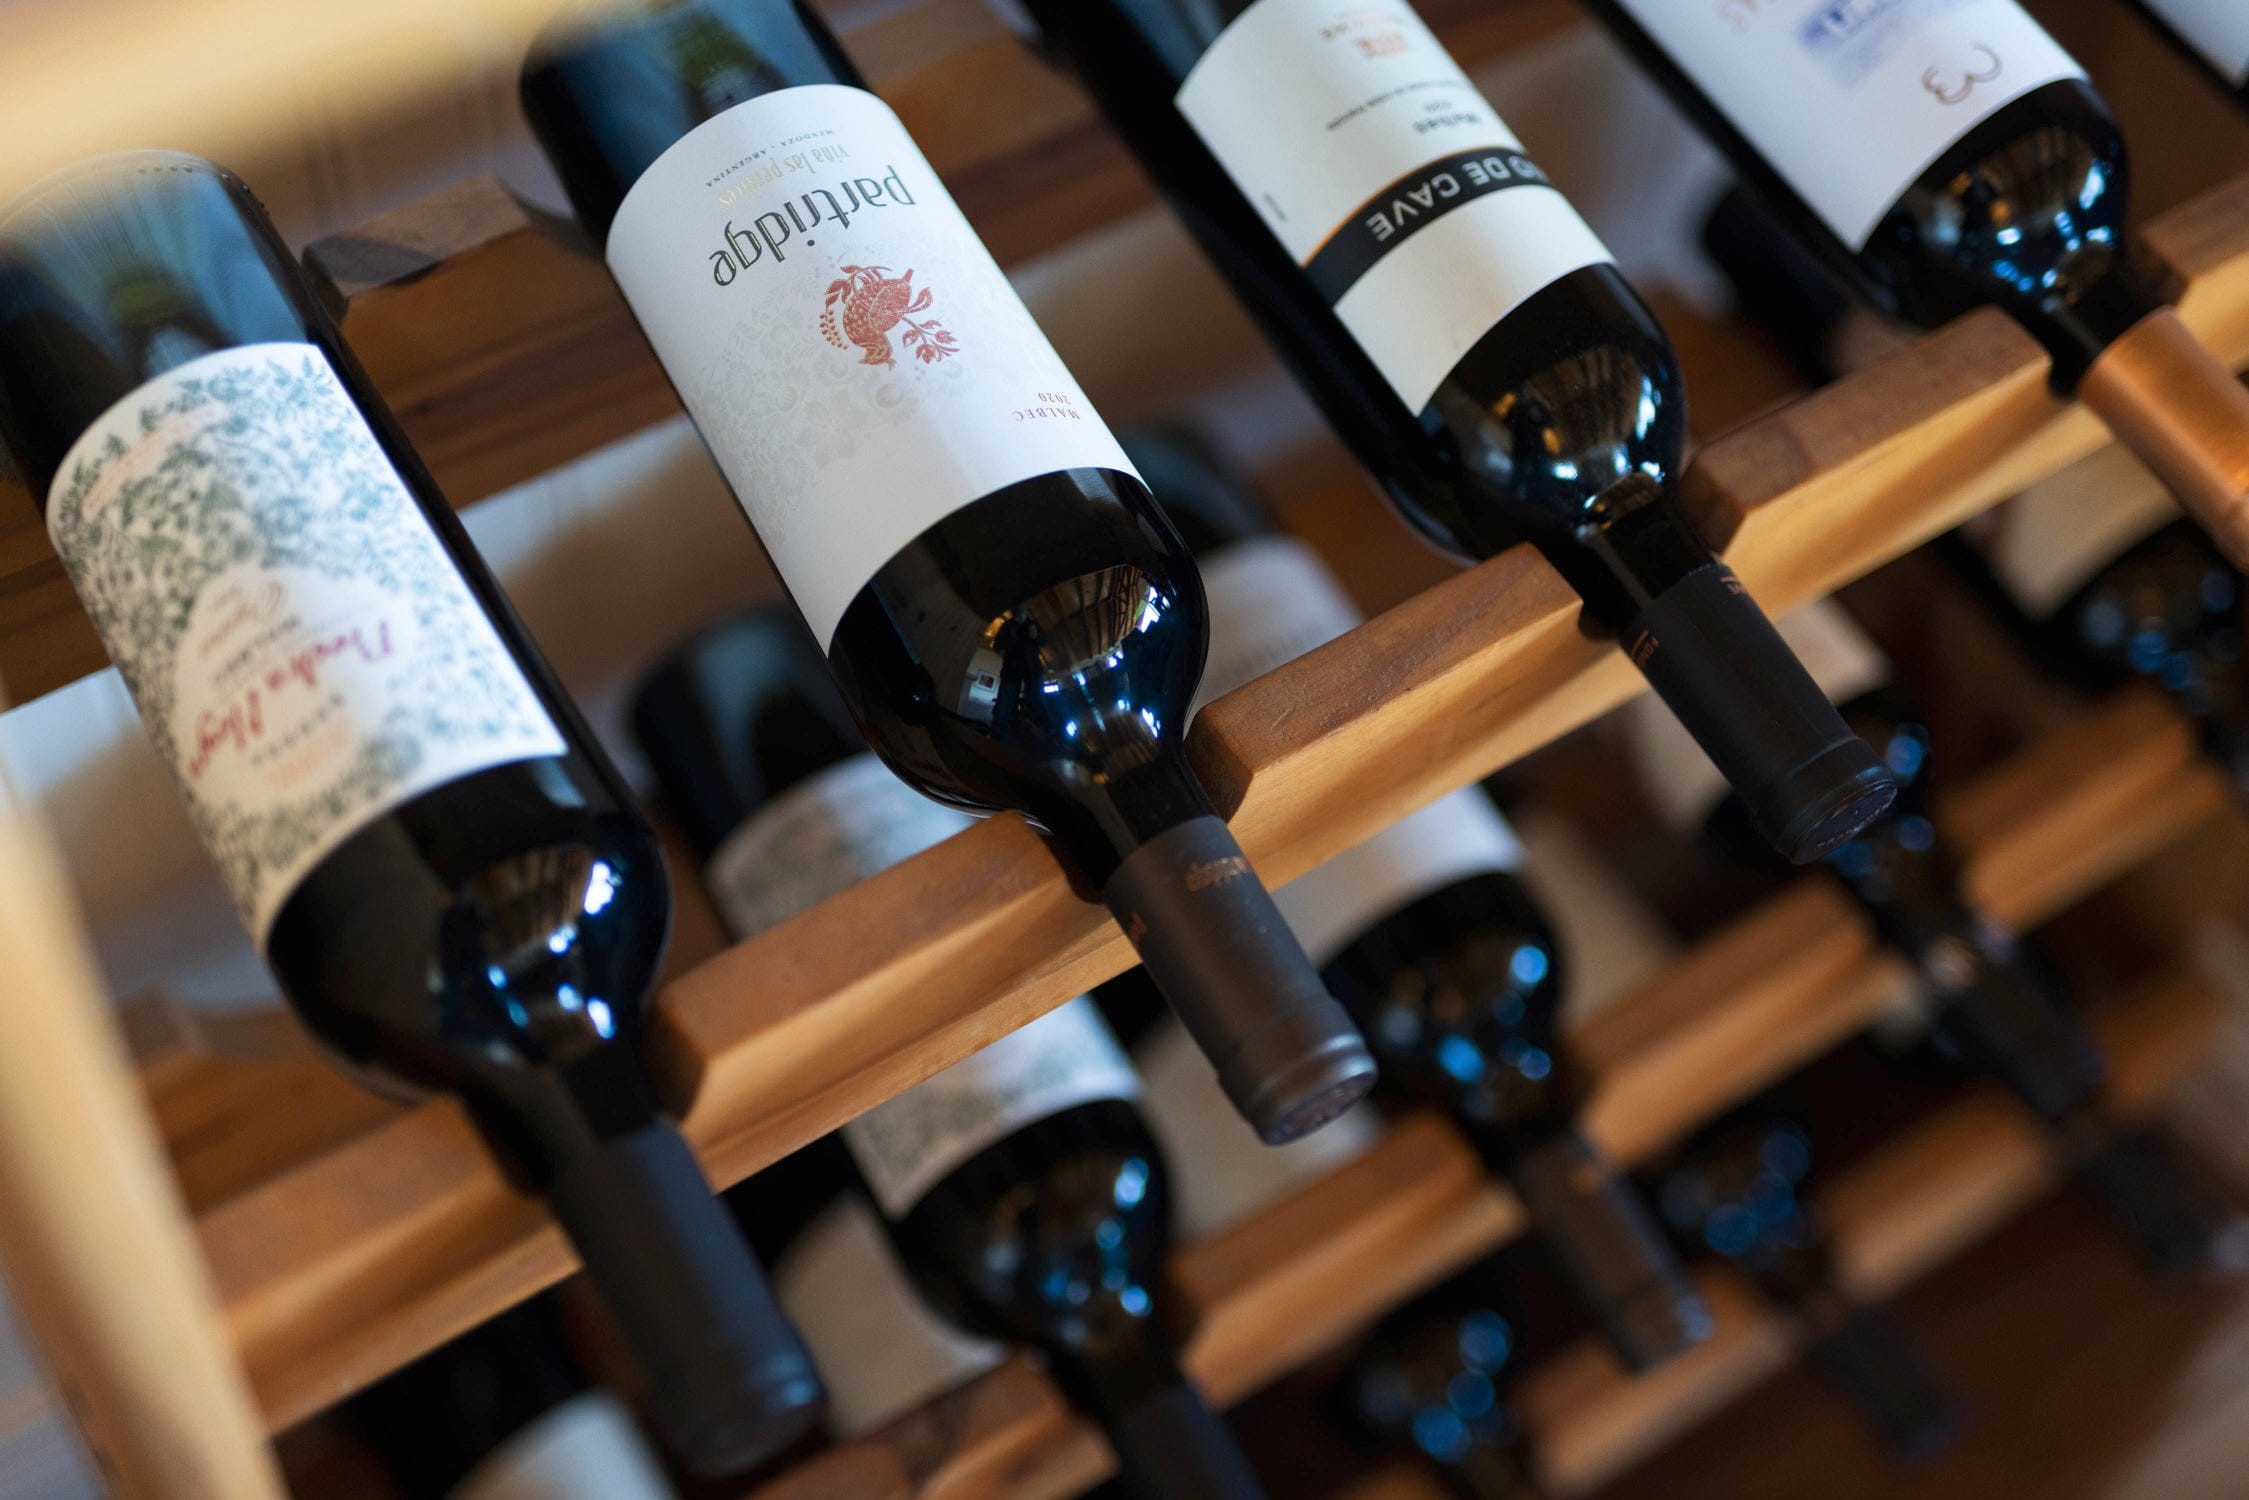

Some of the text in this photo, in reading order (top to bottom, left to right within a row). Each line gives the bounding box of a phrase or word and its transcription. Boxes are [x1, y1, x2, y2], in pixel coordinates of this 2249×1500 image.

[779, 128, 833, 147] MENDOZA
[706, 148, 767, 188] ARGENTINA
[787, 152, 816, 174] las
[1462, 156, 1511, 186] DE
[1365, 172, 1460, 243] CAVE
[709, 164, 916, 287] partridge
[1036, 392, 1071, 405] 2020
[1012, 407, 1081, 422] MALBEC
